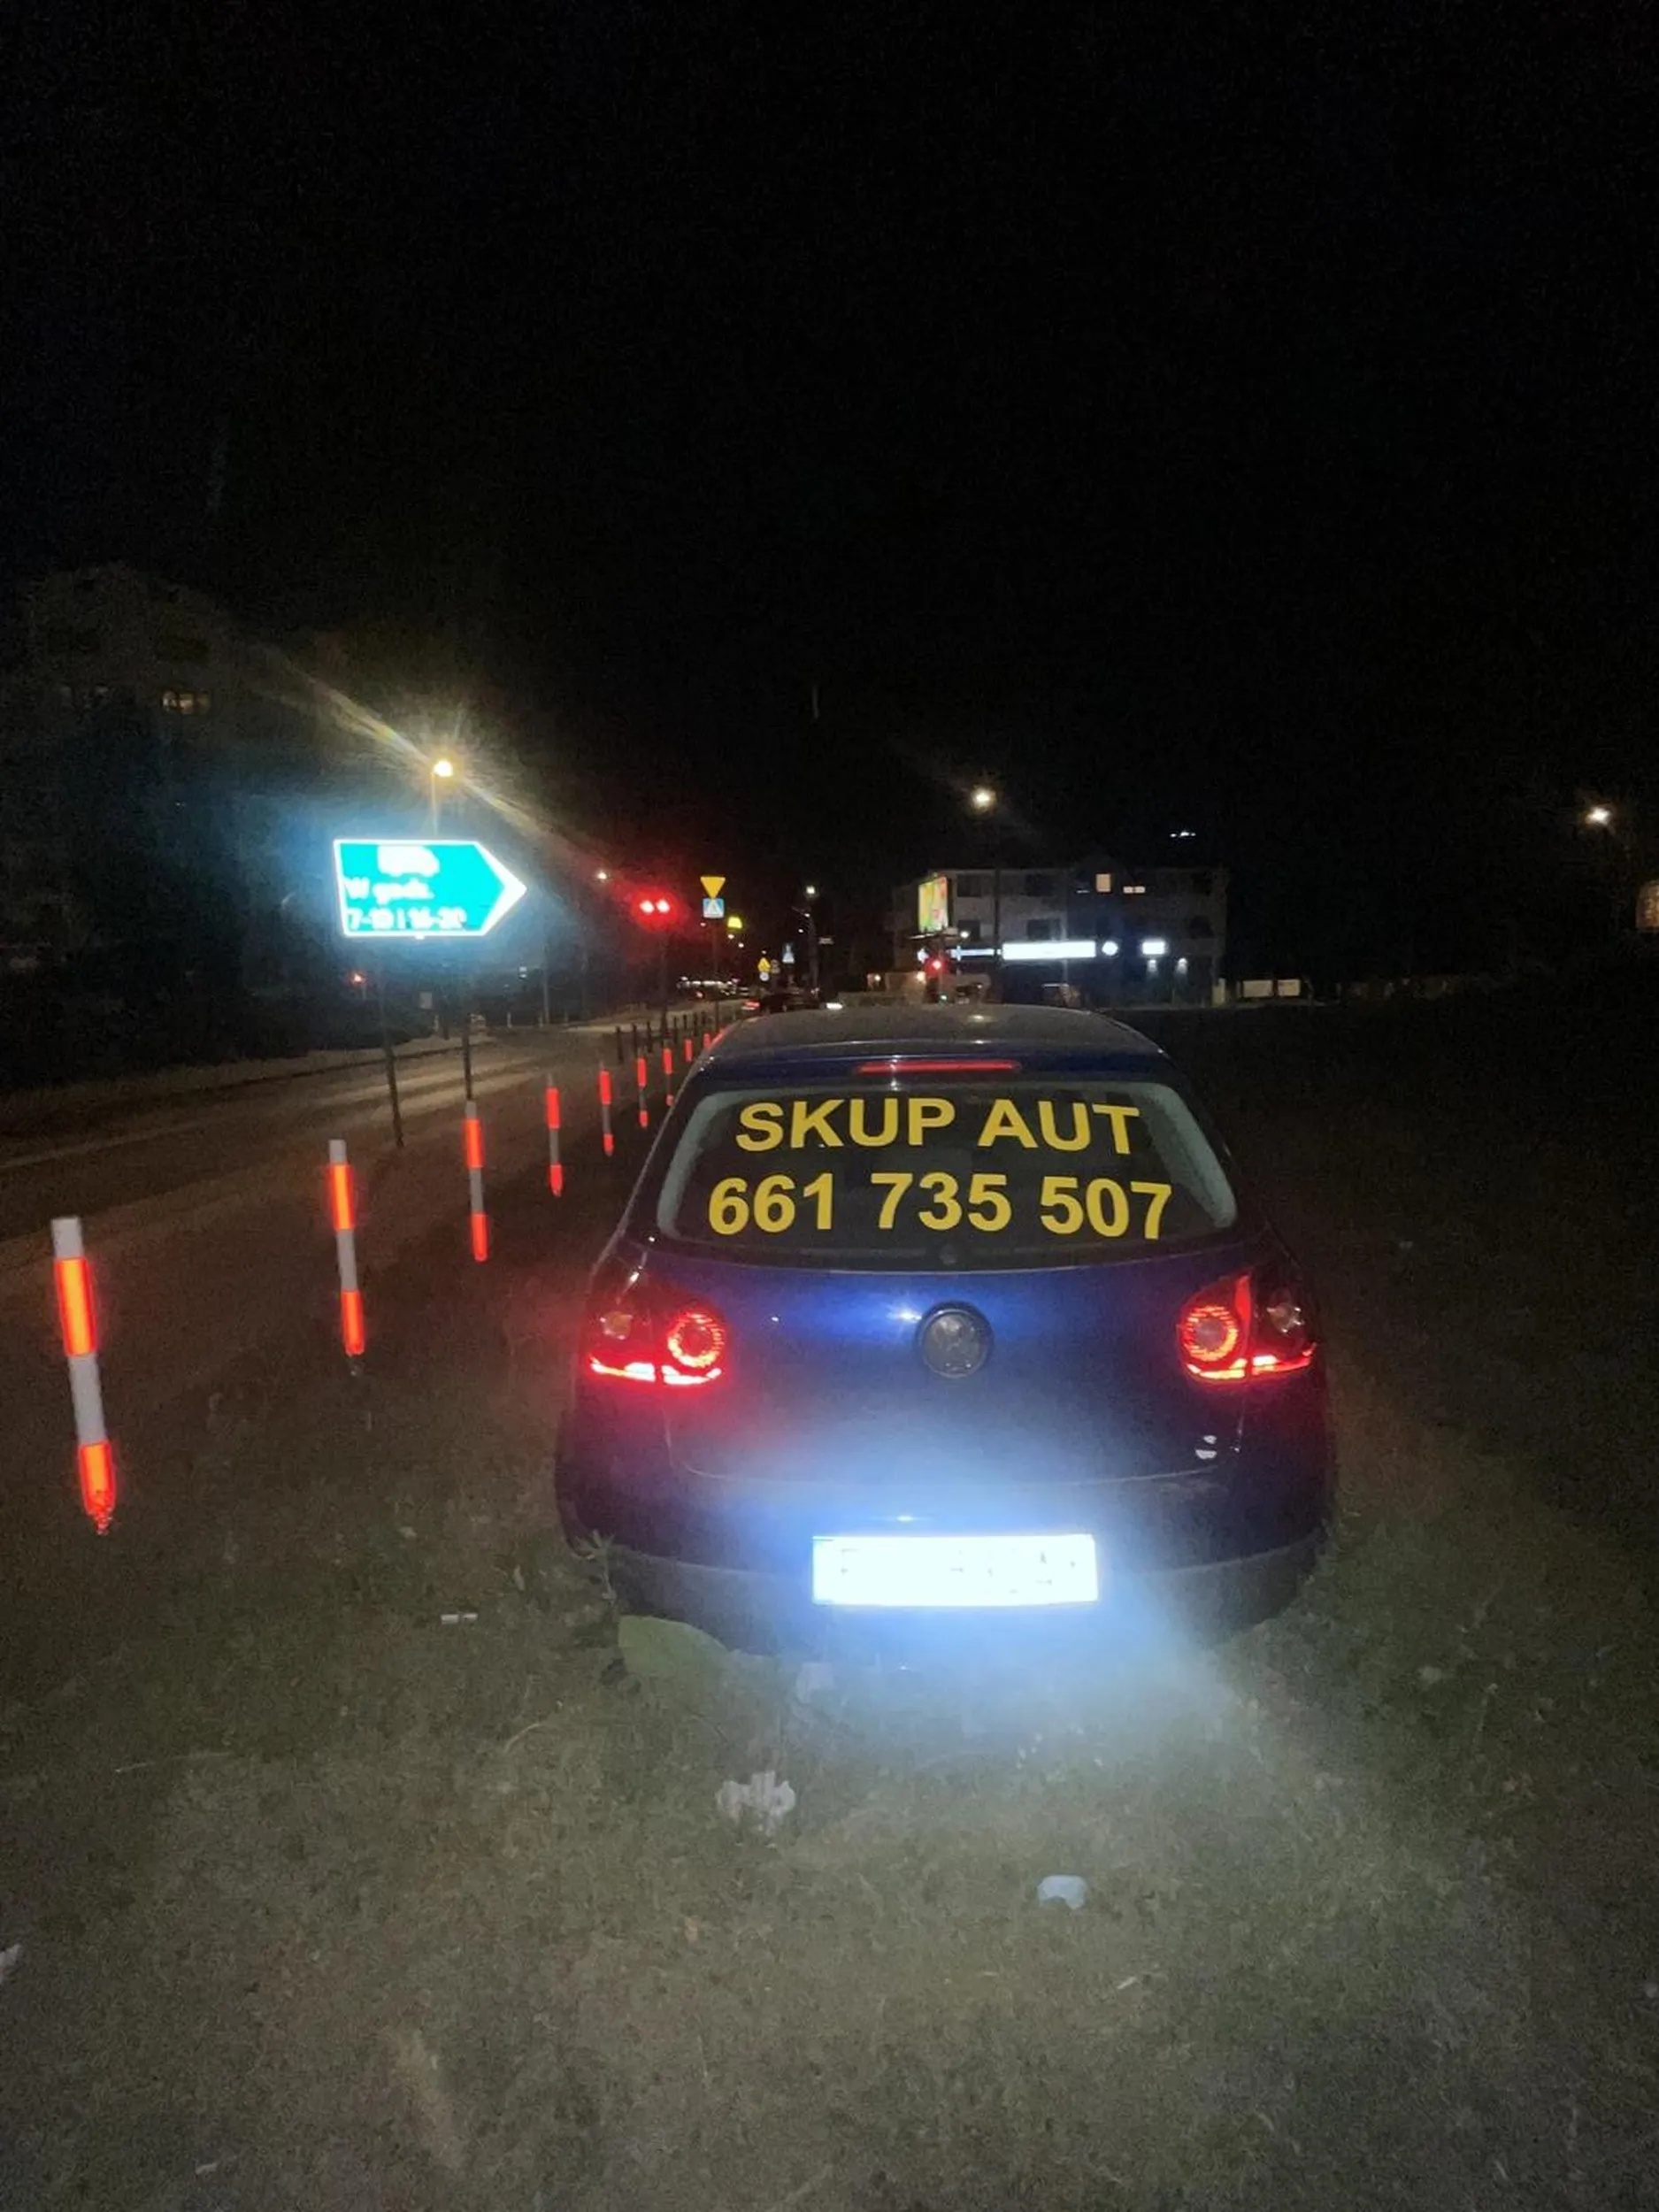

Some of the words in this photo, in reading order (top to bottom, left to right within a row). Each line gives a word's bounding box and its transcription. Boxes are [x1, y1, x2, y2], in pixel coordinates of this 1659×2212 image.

[736, 1099, 955, 1152] SKUP
[978, 1098, 1141, 1156] AUT
[708, 1171, 833, 1236] 661
[872, 1171, 1012, 1232] 735
[1040, 1175, 1172, 1240] 507
